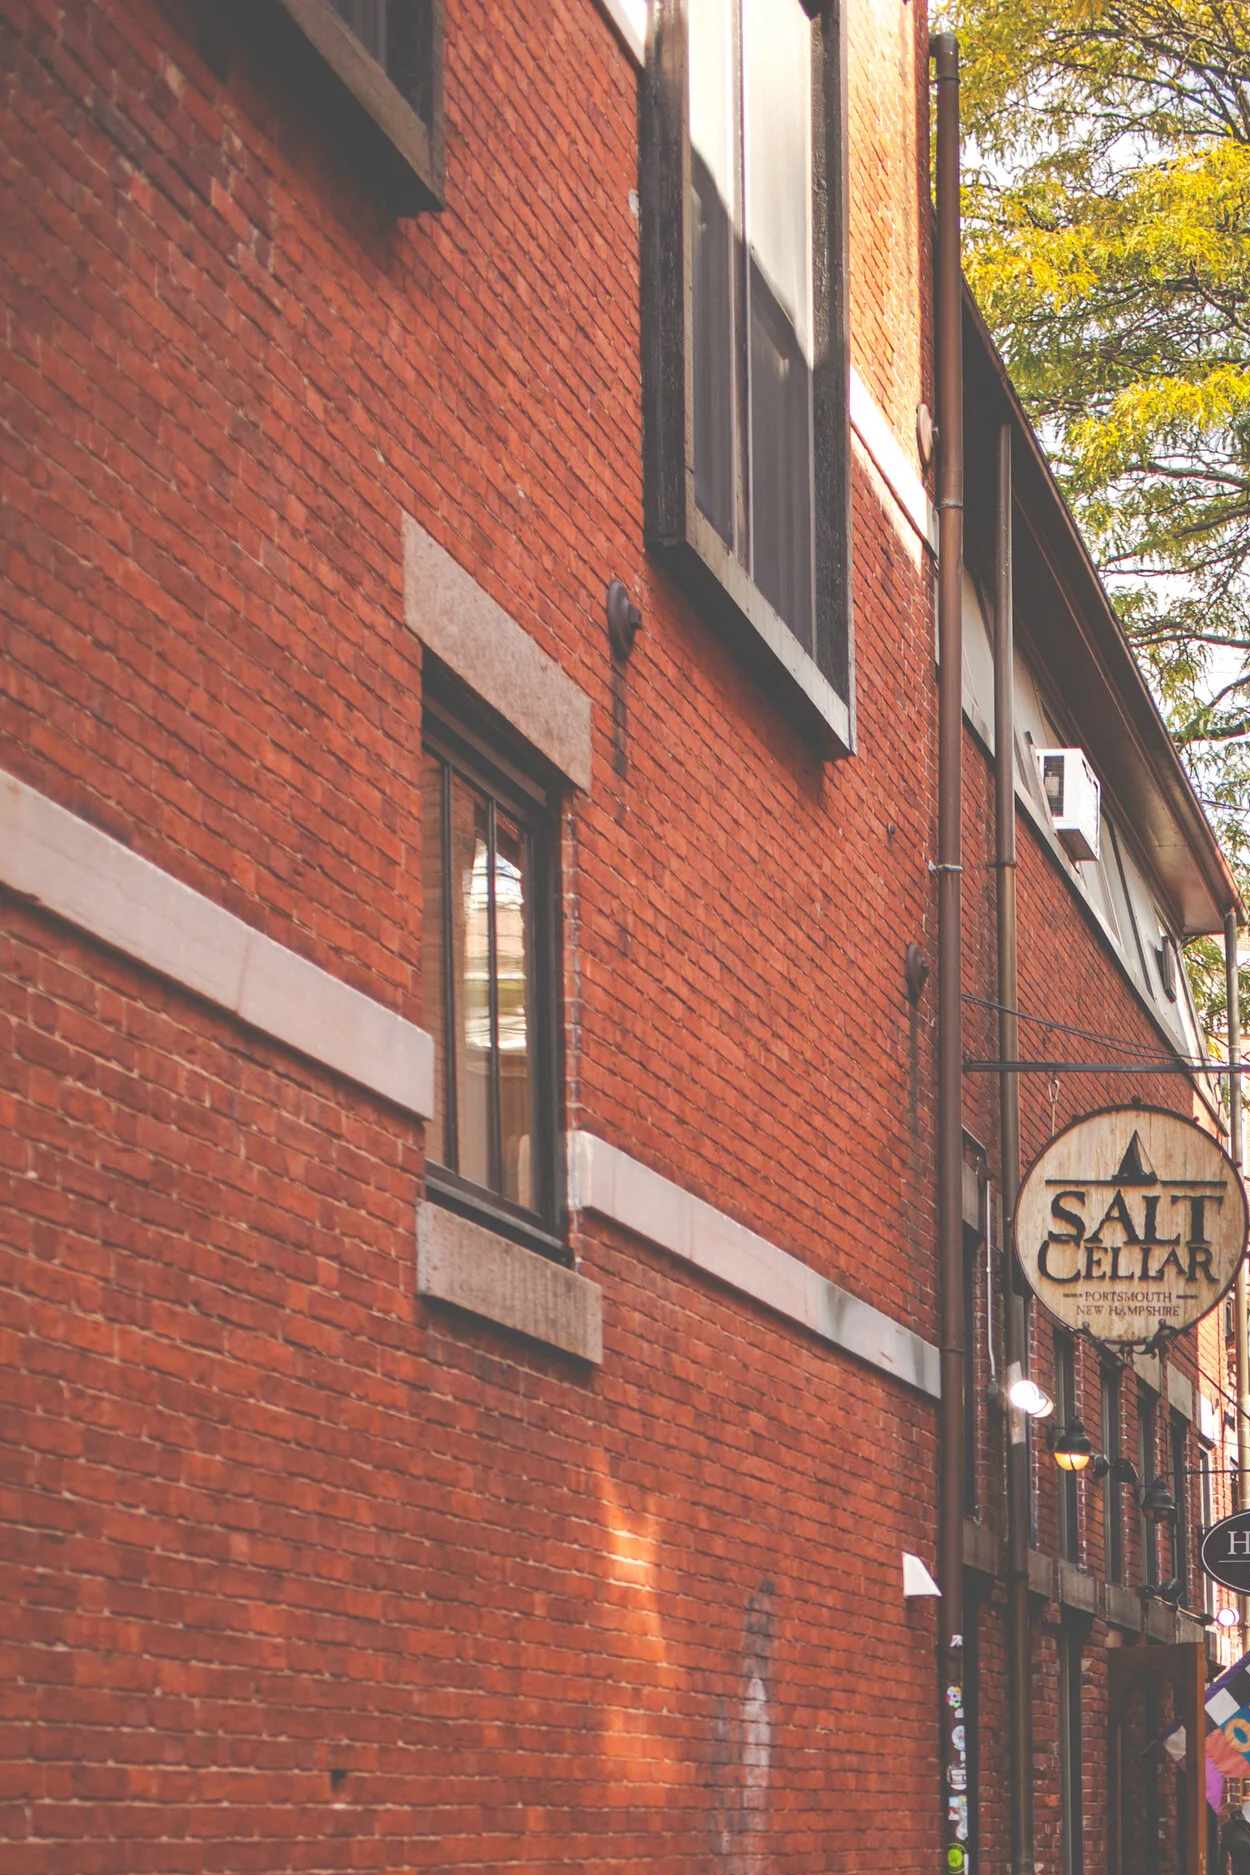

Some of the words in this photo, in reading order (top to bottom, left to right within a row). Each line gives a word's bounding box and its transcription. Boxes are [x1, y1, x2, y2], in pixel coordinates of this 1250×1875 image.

[1047, 1188, 1225, 1247] SALT
[1037, 1240, 1220, 1284] CELLAR
[1076, 1305, 1104, 1316] NEW
[1109, 1304, 1180, 1317] HAMPSHIRE
[1085, 1291, 1172, 1303] PORTSMOUTH
